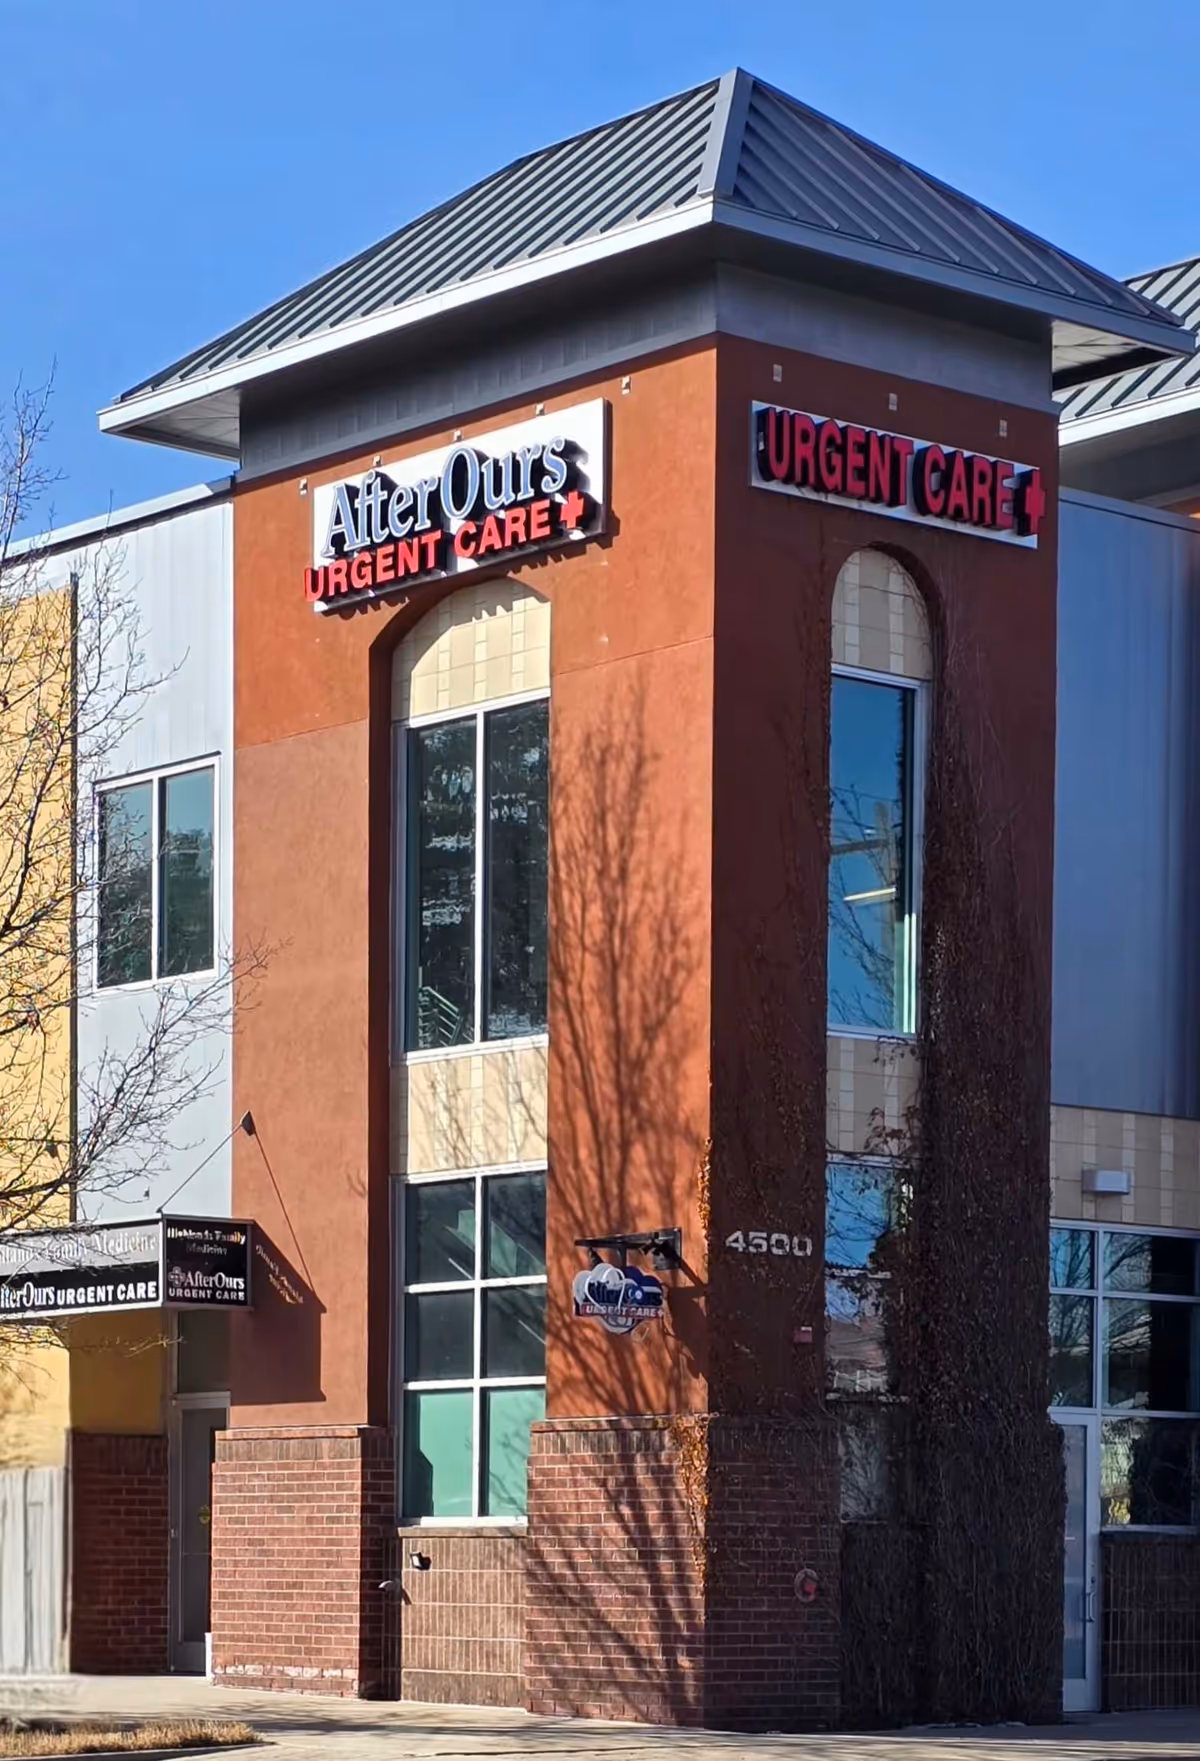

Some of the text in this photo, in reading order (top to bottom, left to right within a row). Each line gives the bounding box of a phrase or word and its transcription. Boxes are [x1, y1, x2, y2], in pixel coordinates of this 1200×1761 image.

[767, 407, 1015, 530] URGENT CARE
[304, 499, 551, 602] URGENT CARE
[725, 1230, 813, 1257] 4500
[57, 1285, 115, 1306] URGENT
[116, 1281, 158, 1301] CARE
[168, 1287, 245, 1301] URGENT CARE
[629, 1307, 656, 1317] CARE
